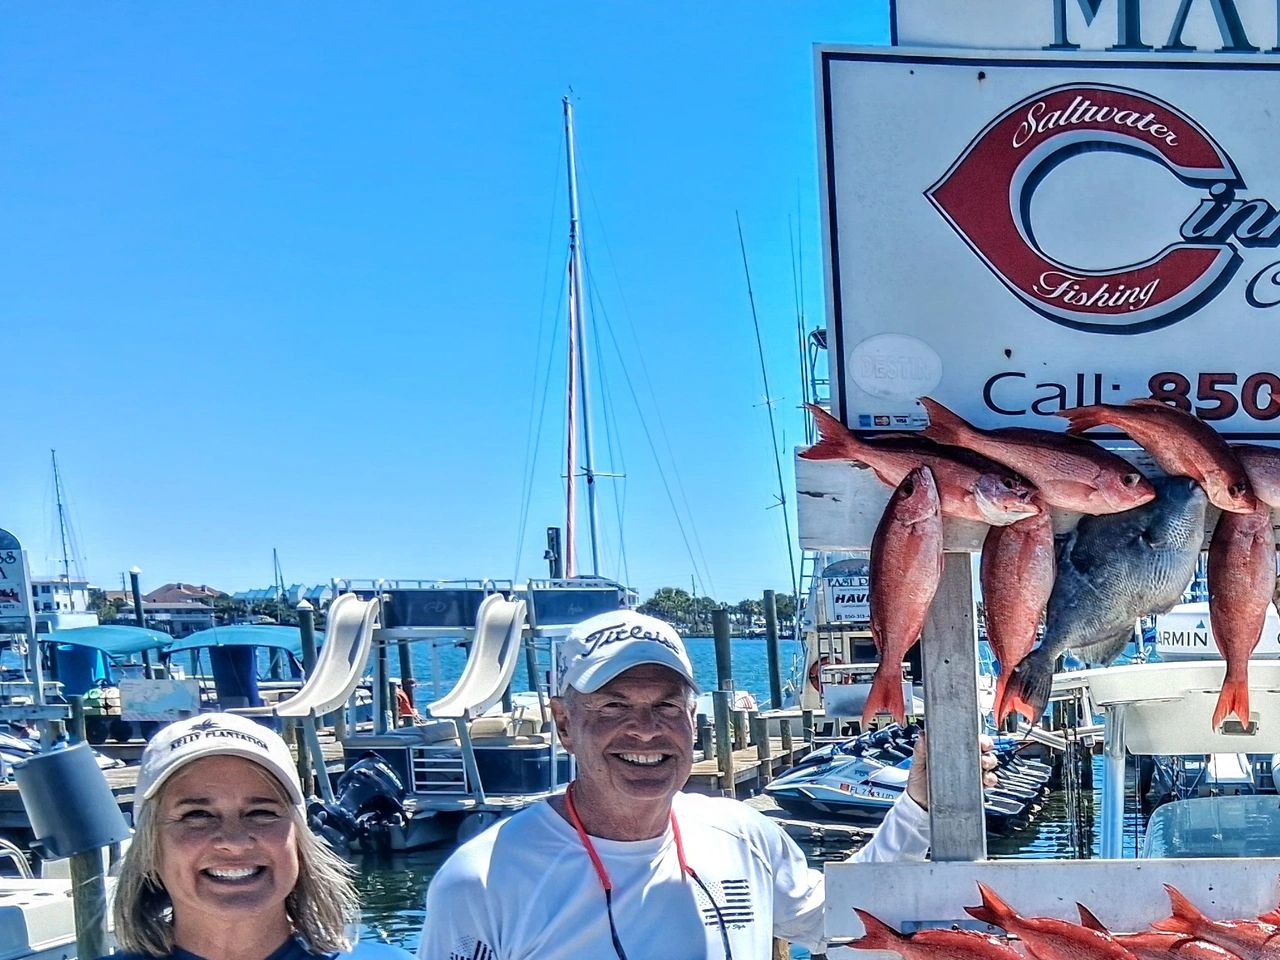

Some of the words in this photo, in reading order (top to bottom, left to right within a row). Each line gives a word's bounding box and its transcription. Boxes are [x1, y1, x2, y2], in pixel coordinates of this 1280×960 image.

[1012, 95, 1179, 149] Saltwater
[1031, 270, 1160, 311] Fishing
[835, 593, 870, 604] HAV
[1157, 631, 1208, 647] ARMIN
